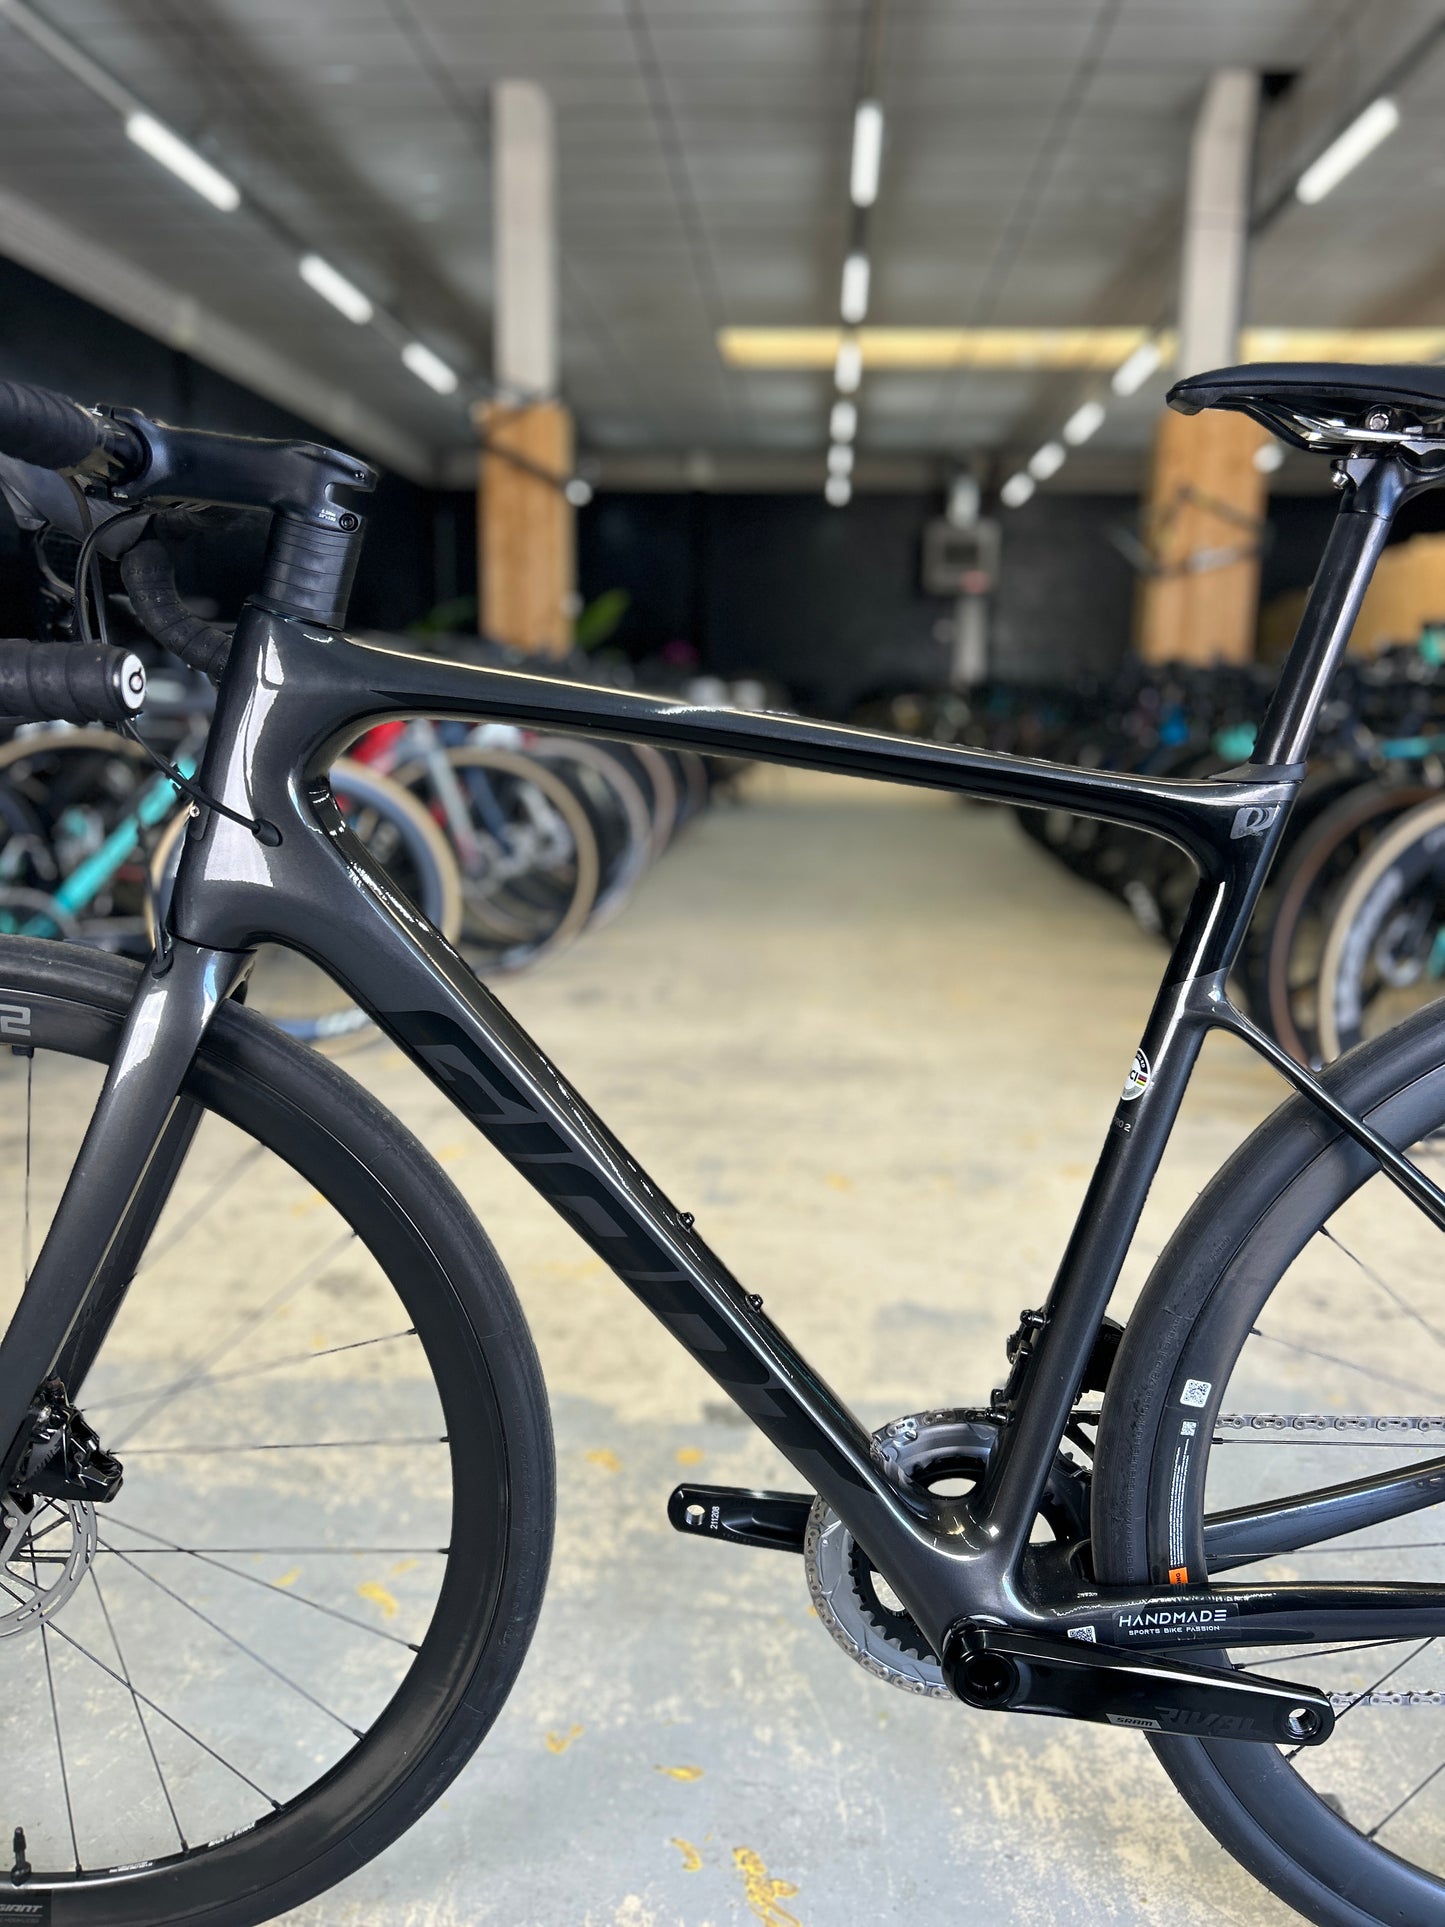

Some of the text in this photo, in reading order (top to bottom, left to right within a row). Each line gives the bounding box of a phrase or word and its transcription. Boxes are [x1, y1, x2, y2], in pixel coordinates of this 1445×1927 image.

[0, 1003, 32, 1037] 2
[1123, 1123, 1132, 1133] 2
[1118, 1609, 1227, 1627] HANDMADE
[1128, 1625, 1221, 1636] SPORTS BIKE PASSION
[1115, 1716, 1153, 1727] SRAM
